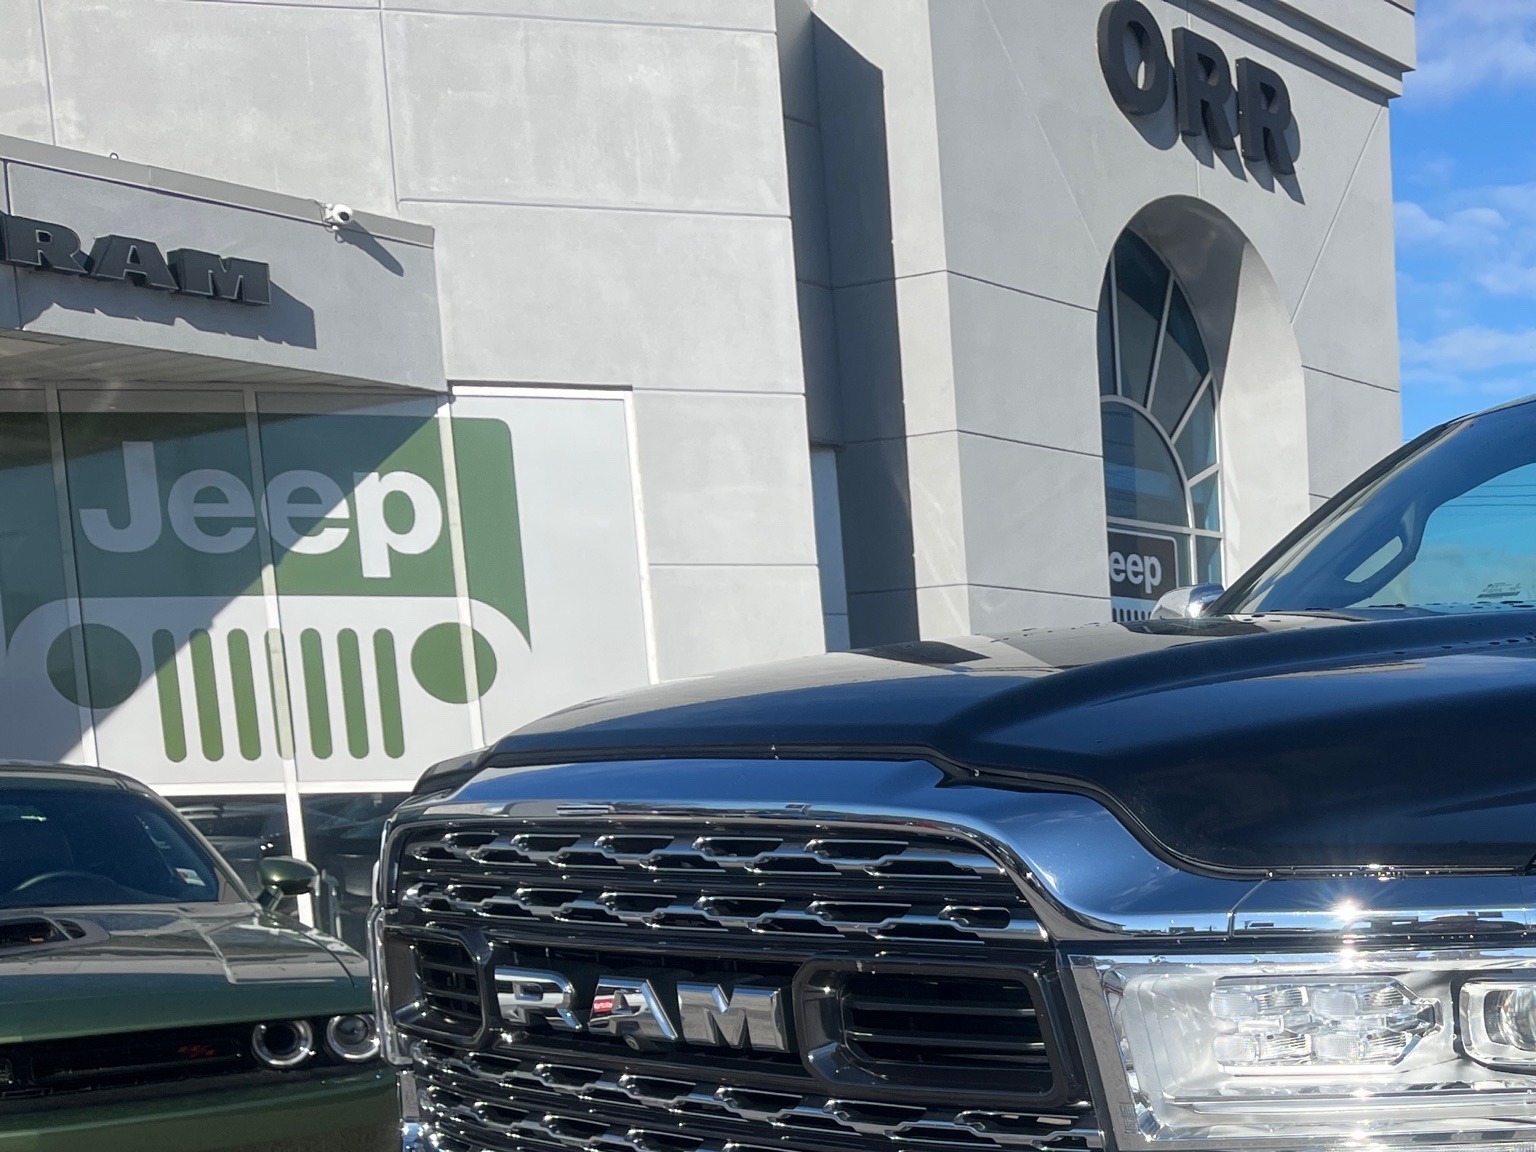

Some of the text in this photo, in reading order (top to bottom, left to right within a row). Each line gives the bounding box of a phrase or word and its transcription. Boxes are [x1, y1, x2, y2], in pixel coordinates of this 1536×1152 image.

[1097, 0, 1296, 175] ORR
[0, 212, 271, 305] RAM
[79, 441, 442, 578] Jeep
[1110, 551, 1162, 594] eep
[494, 967, 789, 1052] RAM
